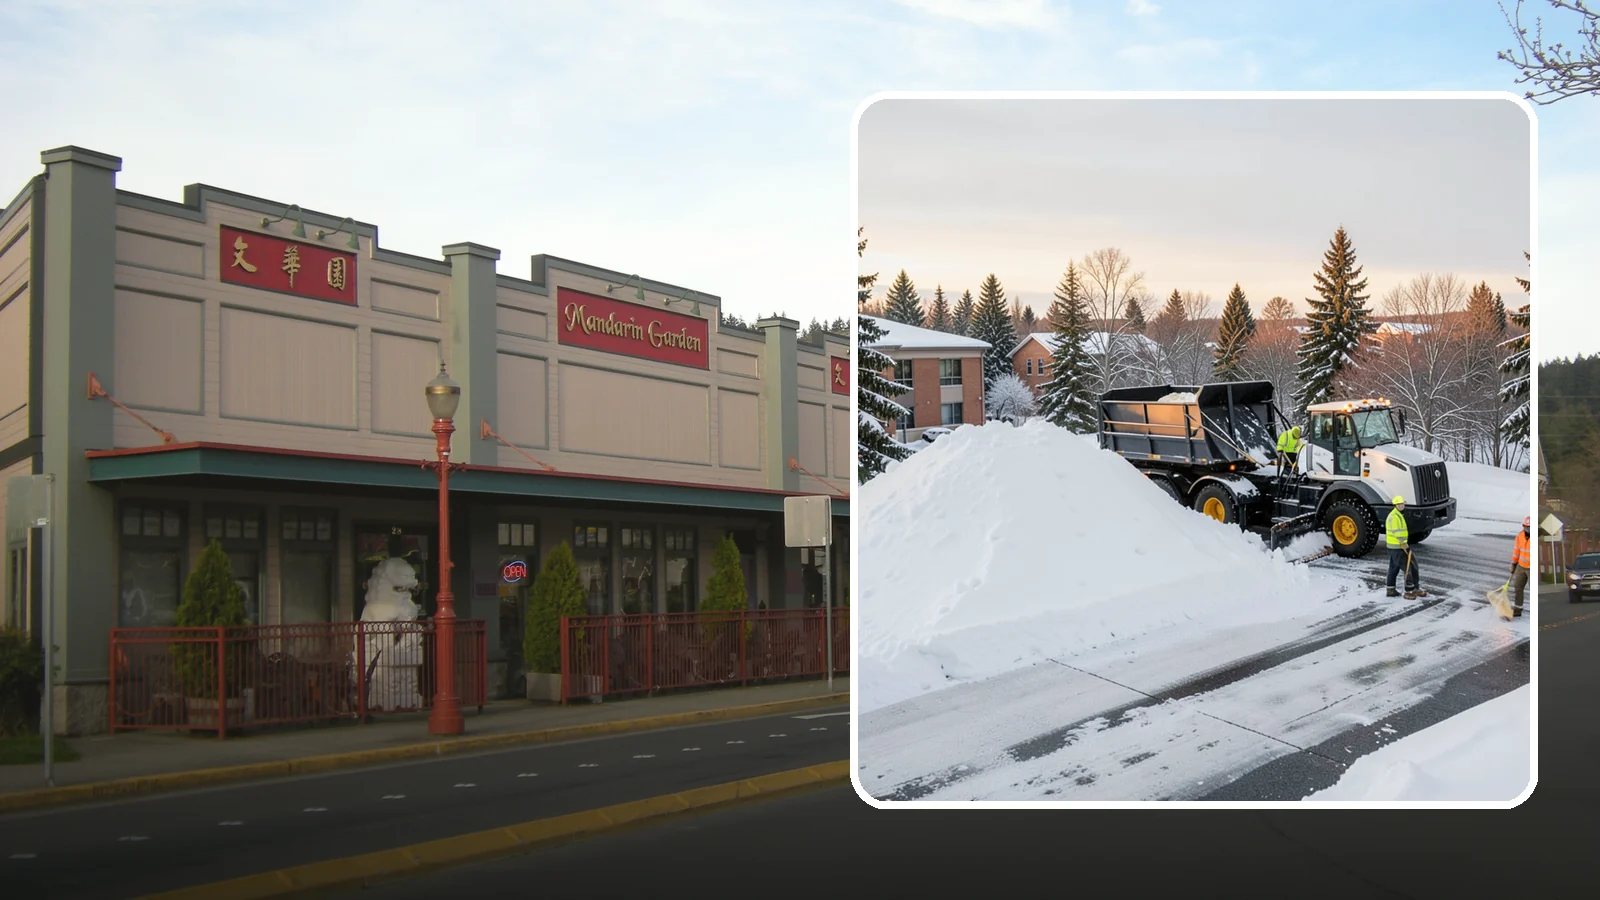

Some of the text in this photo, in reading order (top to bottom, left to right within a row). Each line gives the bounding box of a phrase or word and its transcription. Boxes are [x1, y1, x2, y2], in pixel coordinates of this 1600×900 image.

[230, 235, 346, 291] 文華園
[564, 302, 702, 352] Mandarin Garden
[503, 565, 527, 578] OPEN
